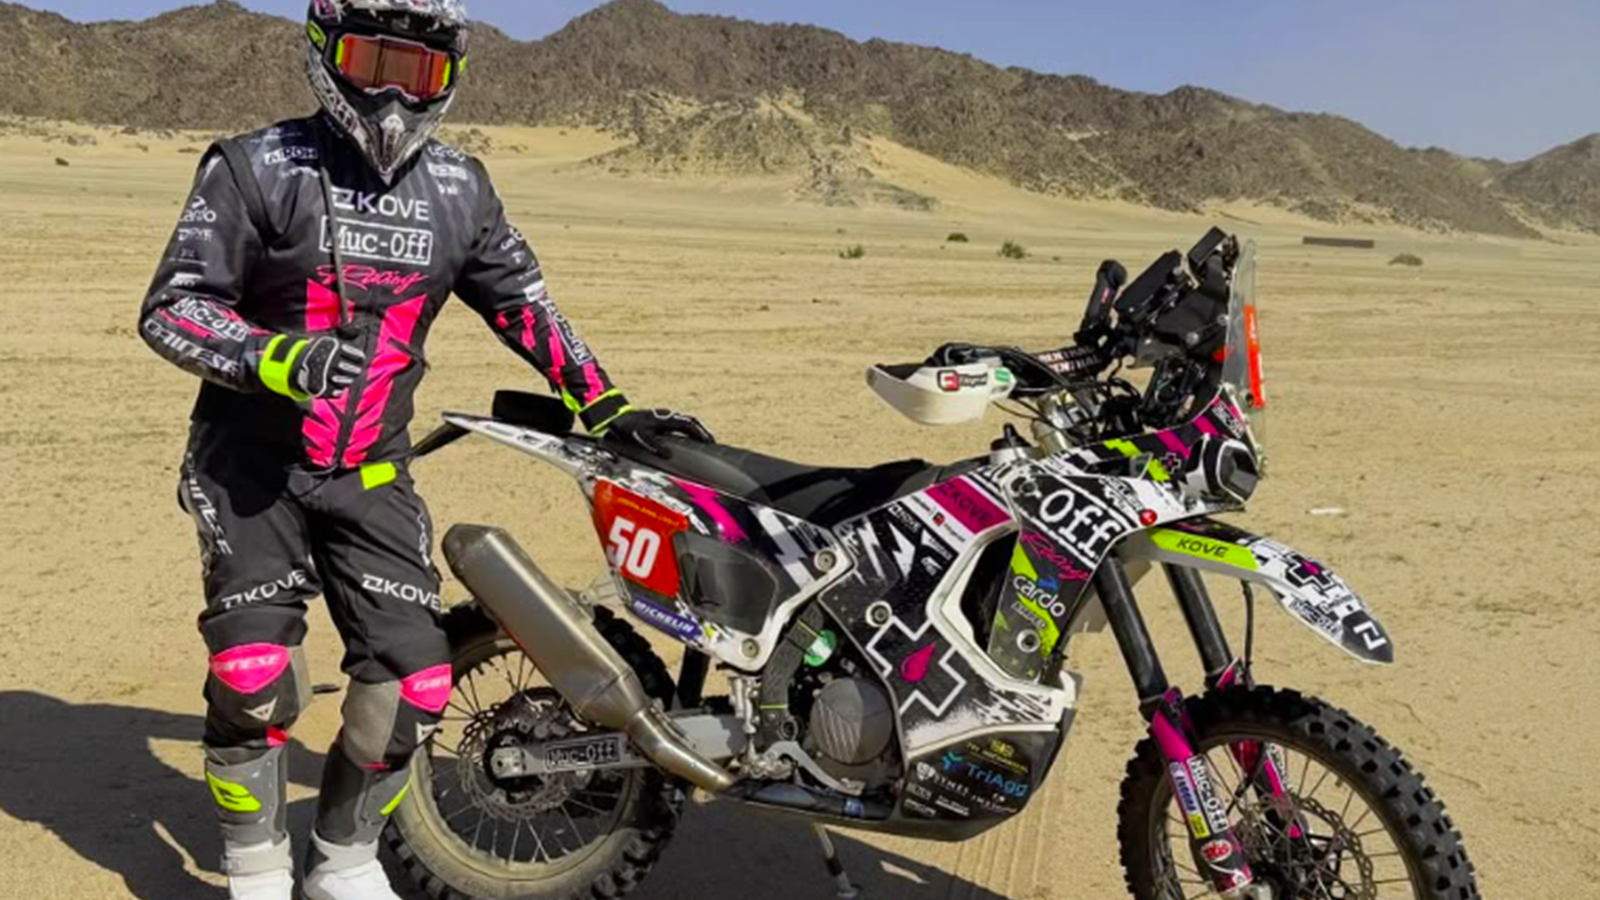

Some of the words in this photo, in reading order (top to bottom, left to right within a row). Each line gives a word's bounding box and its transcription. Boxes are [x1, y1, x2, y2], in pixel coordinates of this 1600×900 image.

[357, 191, 430, 221] KOVE
[607, 515, 661, 579] 50
[1176, 538, 1229, 558] KOVE
[245, 570, 307, 603] KOVE
[383, 578, 441, 612] KOVE
[1013, 576, 1066, 617] cardo
[633, 600, 695, 634] MICHELIN
